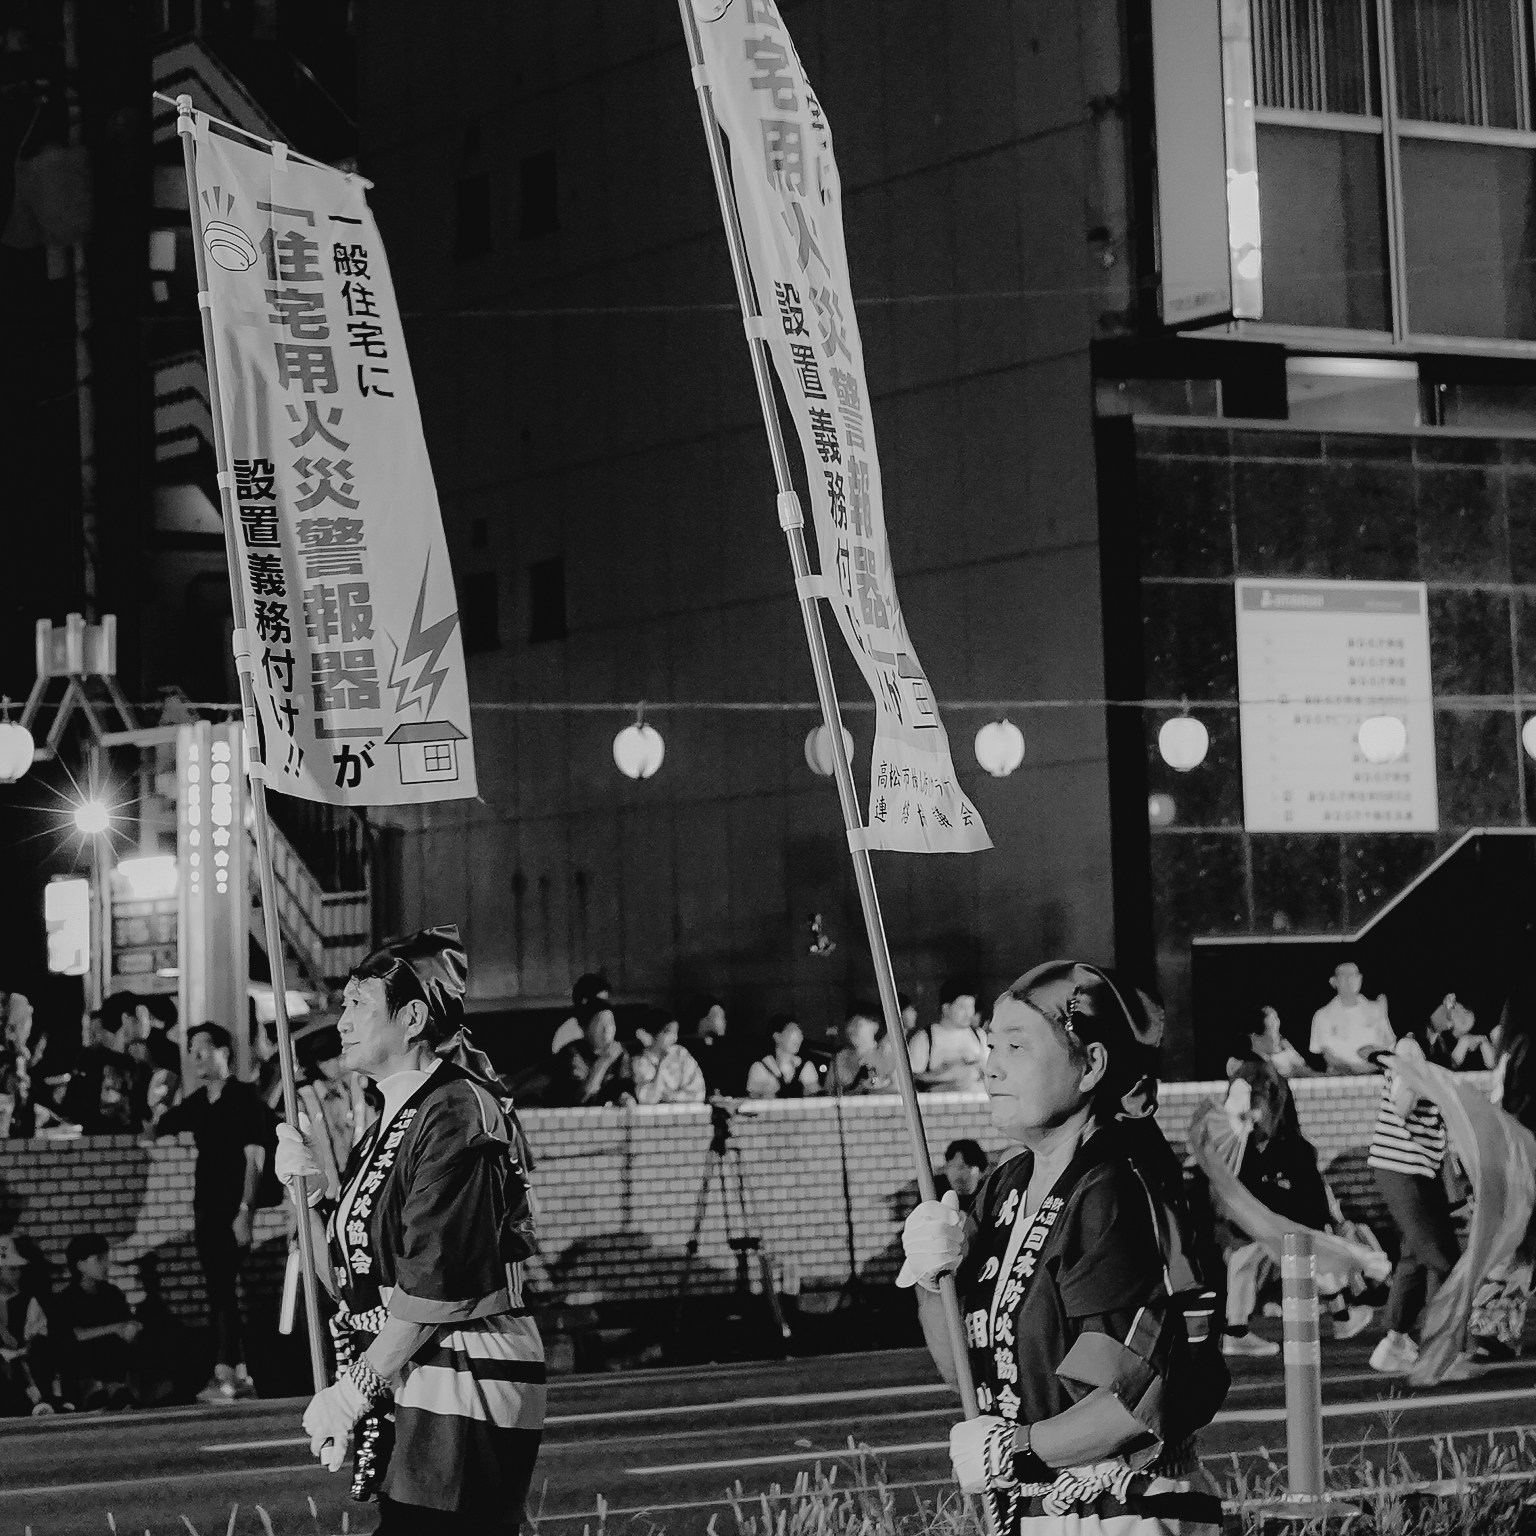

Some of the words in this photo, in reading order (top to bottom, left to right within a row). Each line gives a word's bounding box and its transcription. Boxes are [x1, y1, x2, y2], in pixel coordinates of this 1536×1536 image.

[327, 212, 395, 400] 一般住宅に
